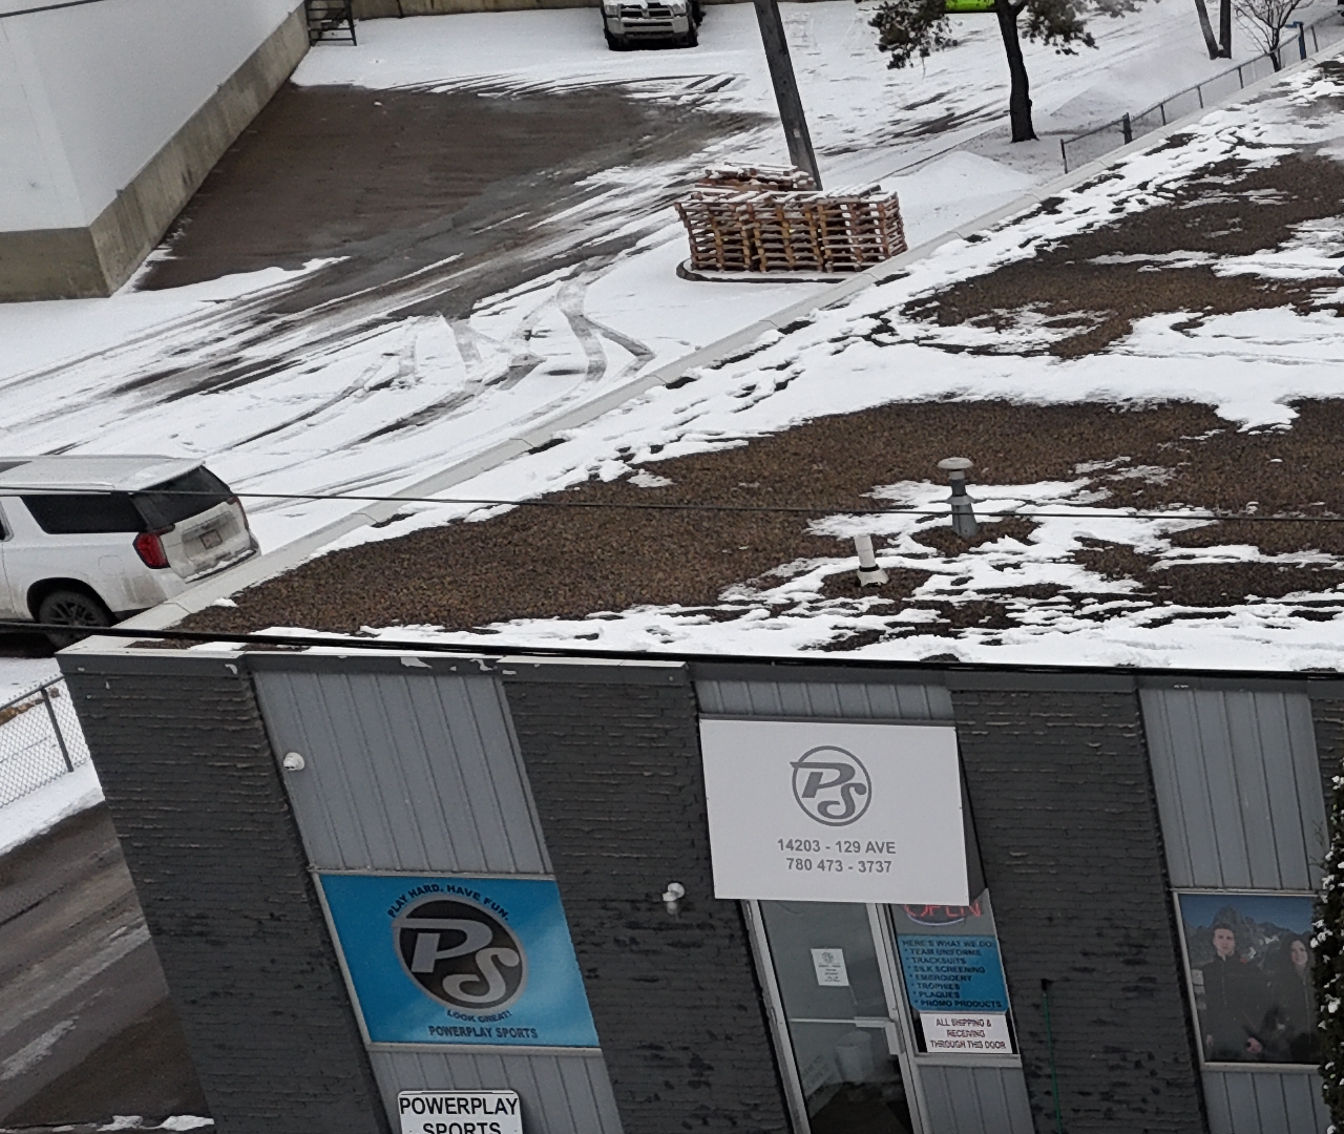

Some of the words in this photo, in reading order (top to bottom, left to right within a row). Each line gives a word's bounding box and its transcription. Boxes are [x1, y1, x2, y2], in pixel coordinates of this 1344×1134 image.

[777, 838, 821, 852] 14203
[835, 840, 861, 853] 129
[865, 841, 897, 854] AVE
[786, 858, 813, 871] 780
[817, 859, 844, 872] 473
[857, 860, 892, 873] 3737
[387, 894, 408, 918] PLAY
[408, 883, 445, 899] HARD.
[446, 884, 481, 901] HAVE
[483, 897, 510, 920] FUN.
[911, 957, 967, 965] TRACKSUITS
[913, 965, 935, 973] SILK
[935, 966, 986, 974] SCREENING
[915, 974, 973, 982] EMBROIDERY
[917, 982, 961, 990] TROPHIES
[920, 999, 953, 1007] PROMO
[954, 1000, 1003, 1008] PRODUCTS
[446, 1009, 476, 1022] LOOK
[477, 1010, 512, 1023] GREAT!
[936, 1018, 950, 1027] ALL
[428, 1025, 493, 1038] POWERPLAY
[496, 1026, 538, 1039] SPORTS
[946, 1029, 986, 1037] RECEIVING
[984, 1041, 1007, 1050] DOOR
[399, 1097, 518, 1115] POWERPLAY
